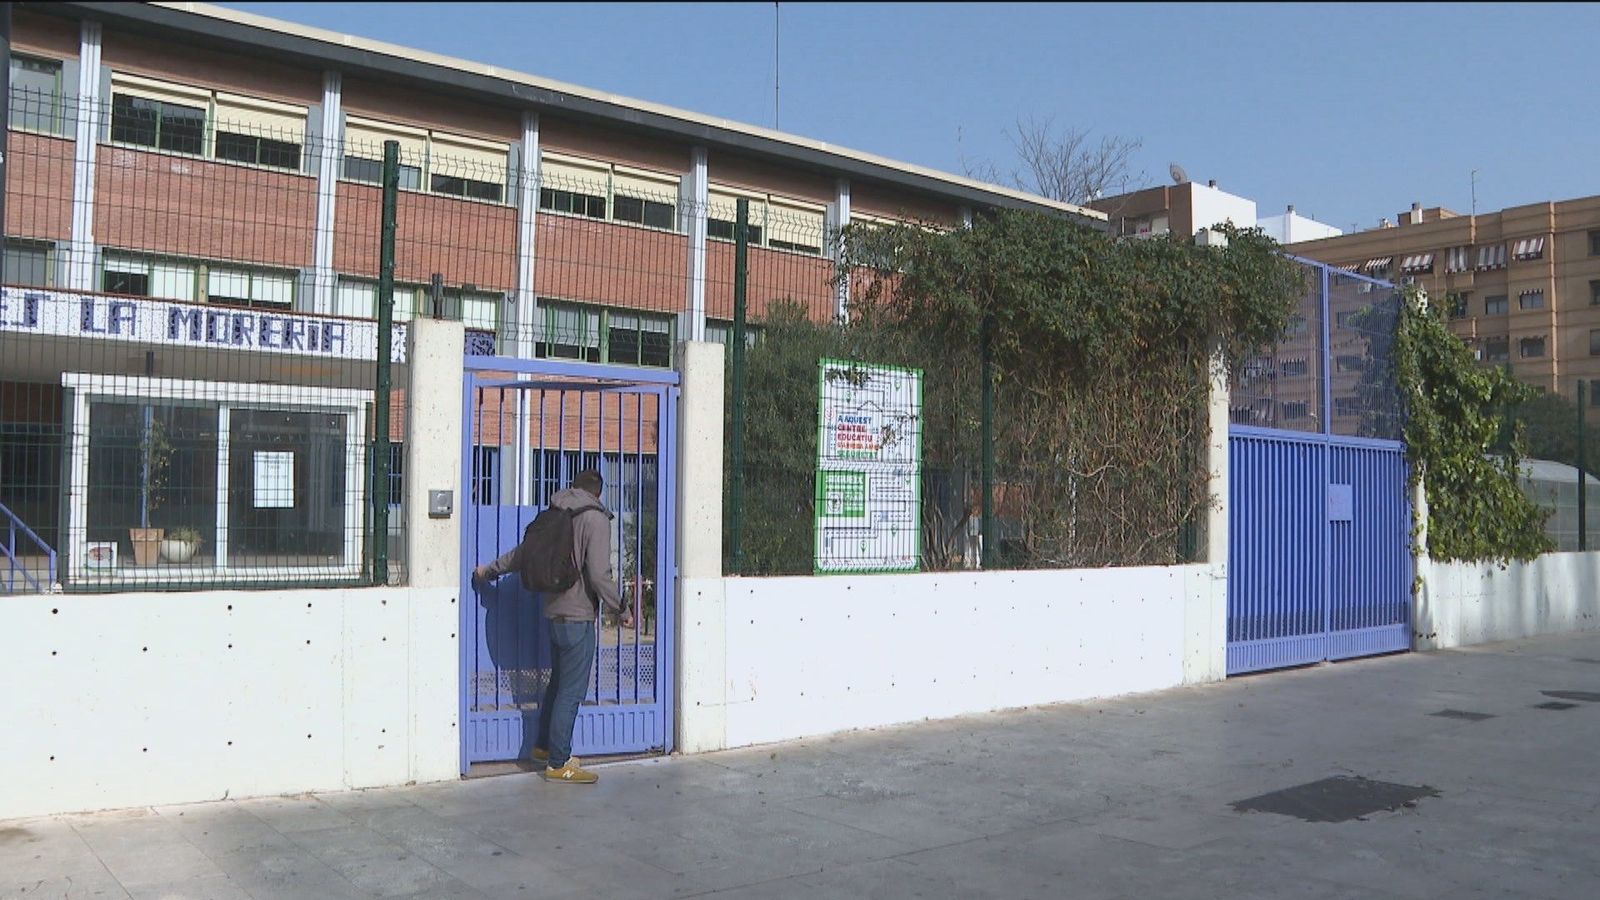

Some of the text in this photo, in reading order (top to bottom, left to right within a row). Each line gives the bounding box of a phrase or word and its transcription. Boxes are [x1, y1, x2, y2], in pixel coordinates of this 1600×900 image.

[79, 298, 137, 336] LA
[844, 416, 871, 424] AQUEST
[837, 424, 866, 432] CENTRE
[837, 434, 872, 442] EDUCATIU
